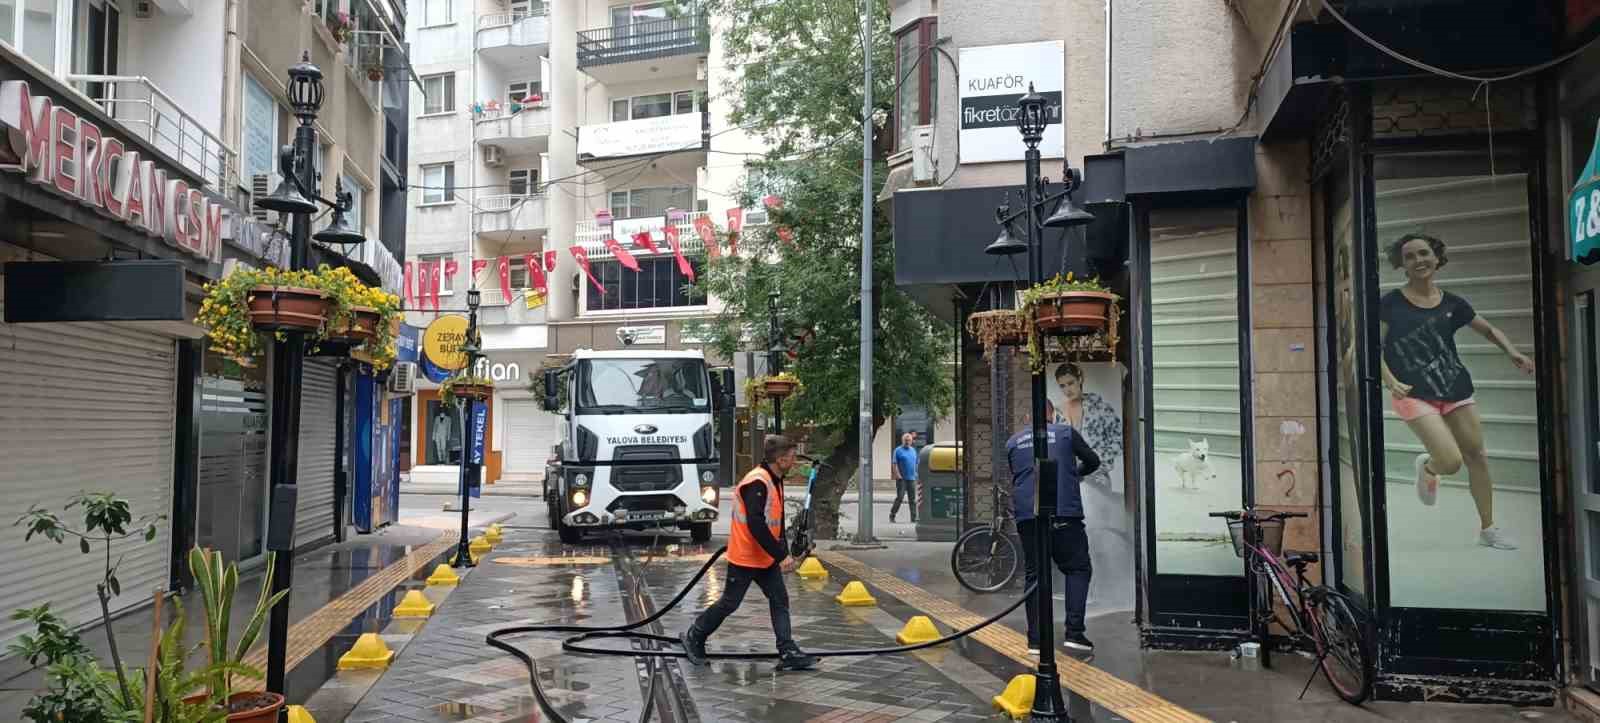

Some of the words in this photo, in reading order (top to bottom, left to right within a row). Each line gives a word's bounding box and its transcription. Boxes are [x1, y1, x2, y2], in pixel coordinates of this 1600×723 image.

[968, 74, 1024, 91] KUAFÖR
[19, 80, 167, 238] MERCAN
[174, 180, 221, 264] GSM
[475, 409, 486, 448] TEKEL
[607, 436, 639, 445] YALOVA
